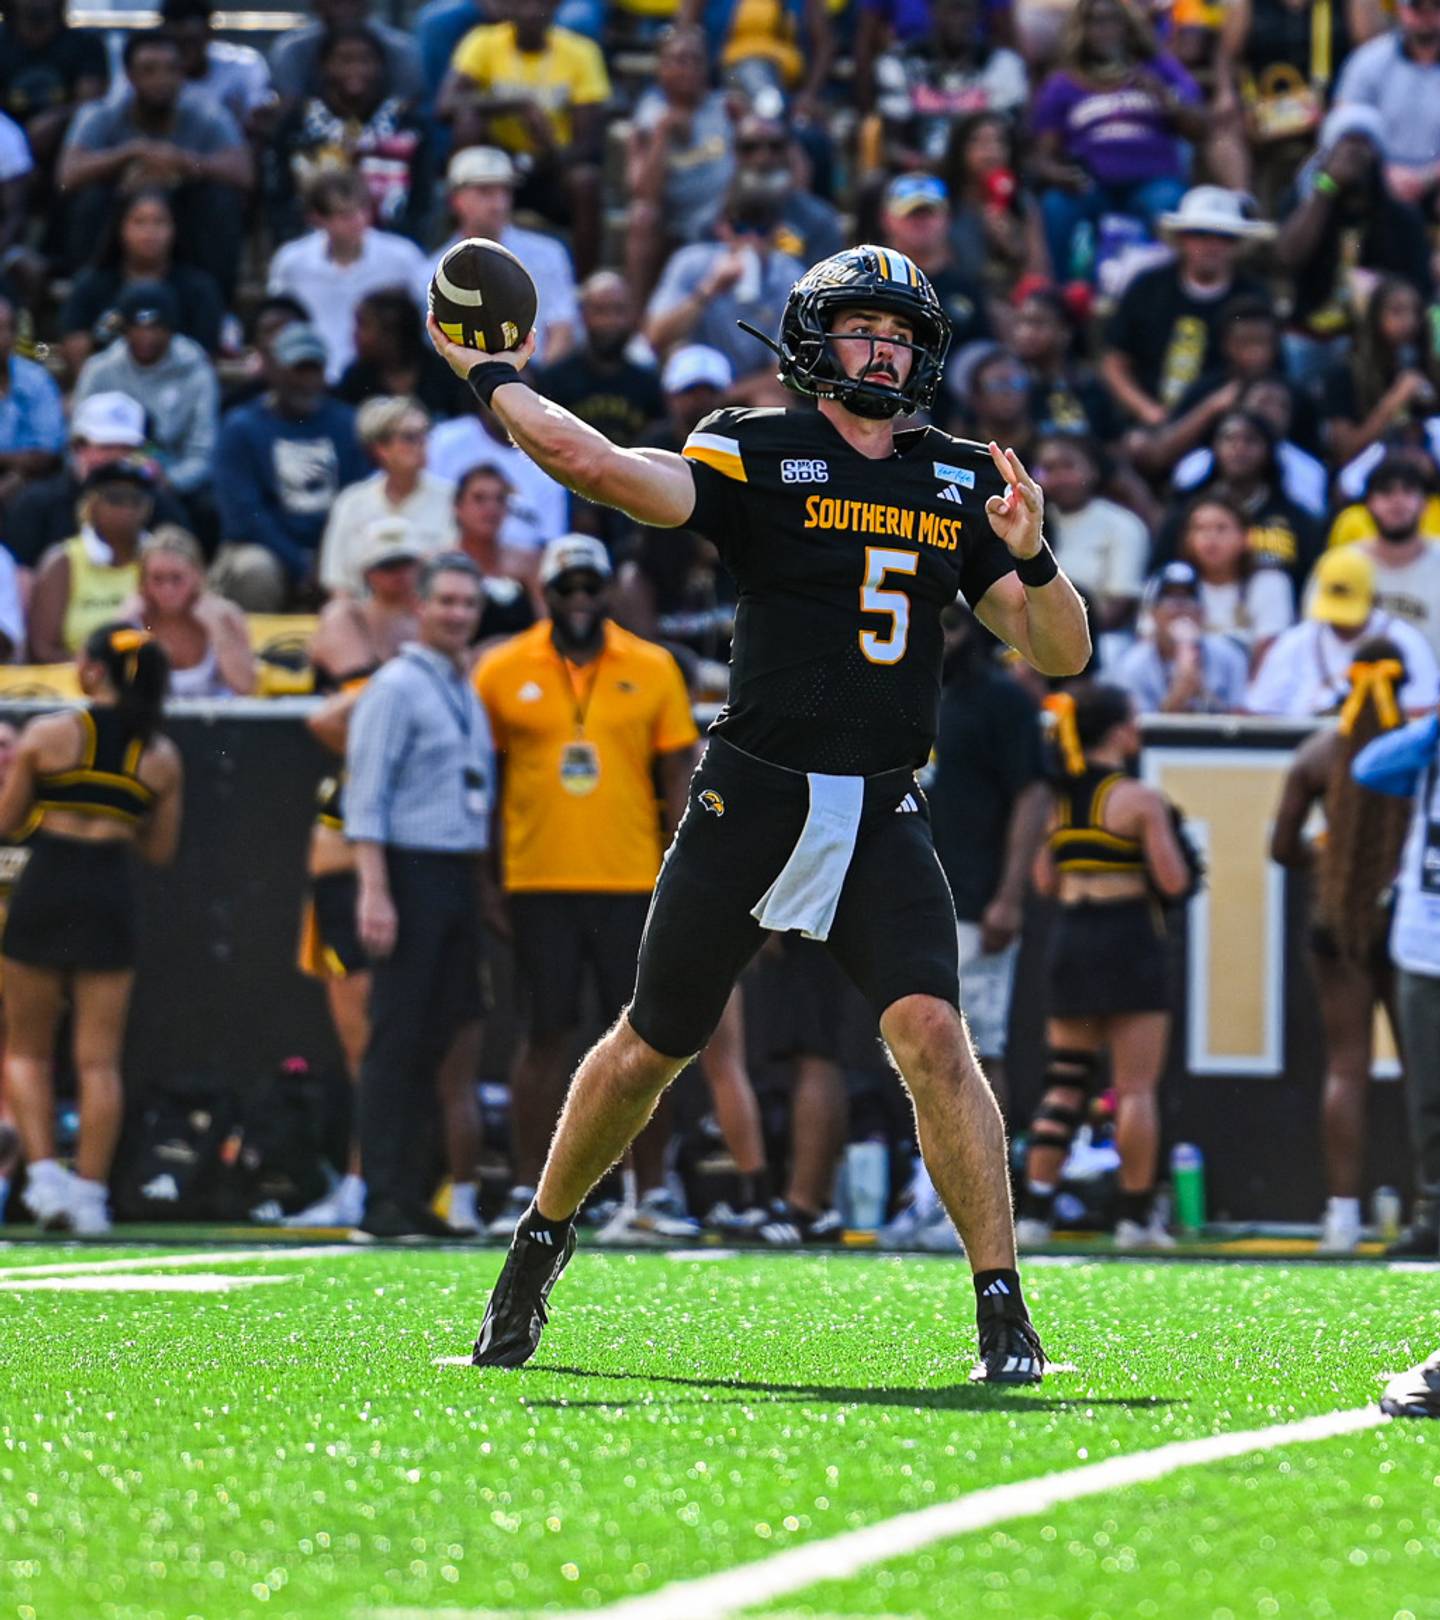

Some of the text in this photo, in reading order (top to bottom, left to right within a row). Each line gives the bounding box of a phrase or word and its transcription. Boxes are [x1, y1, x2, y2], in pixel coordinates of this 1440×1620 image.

[780, 459, 829, 484] SBC
[804, 495, 962, 551] SOUTHERN MISS
[858, 545, 920, 666] 5
